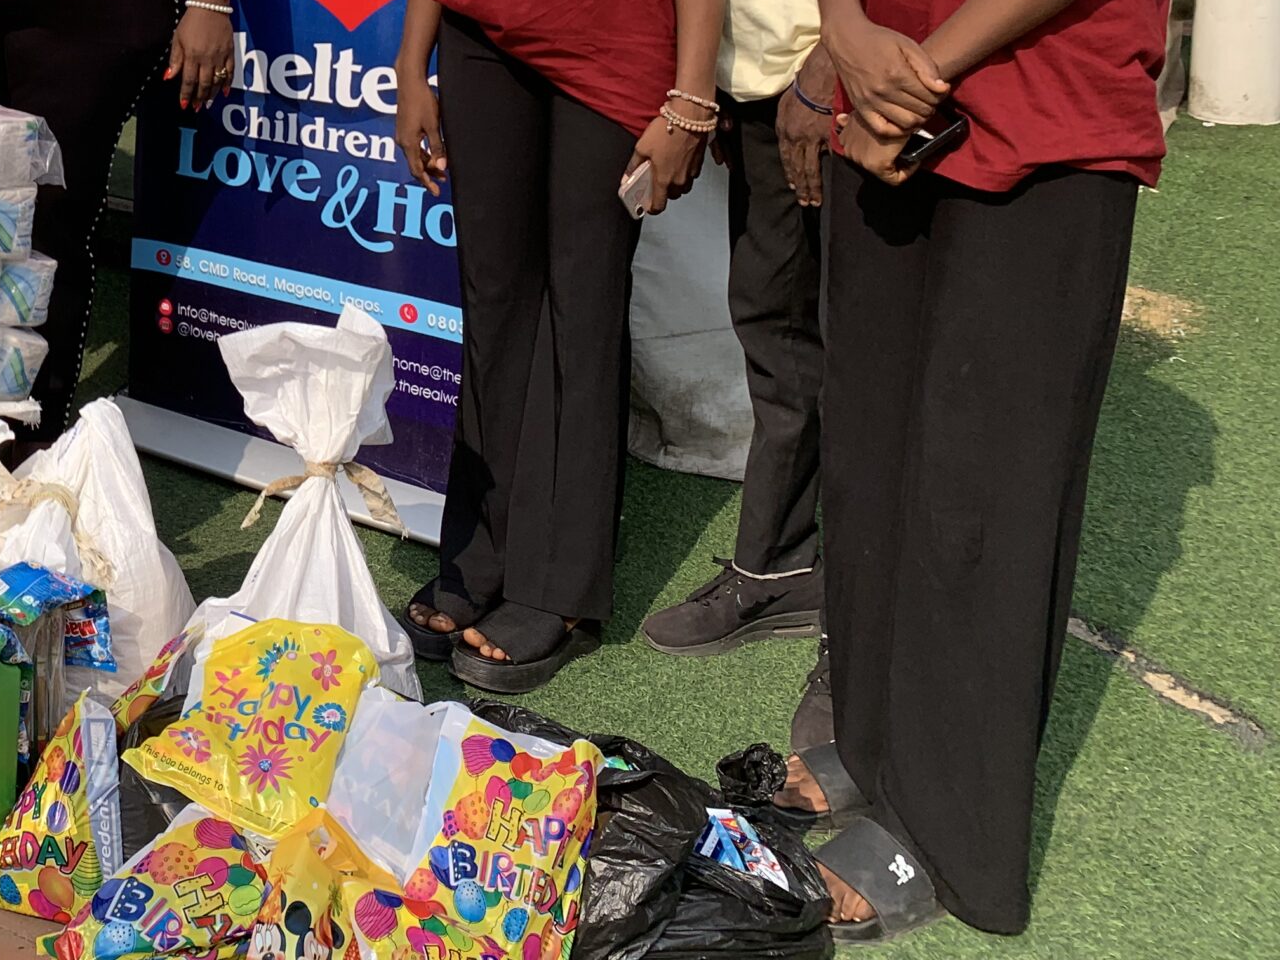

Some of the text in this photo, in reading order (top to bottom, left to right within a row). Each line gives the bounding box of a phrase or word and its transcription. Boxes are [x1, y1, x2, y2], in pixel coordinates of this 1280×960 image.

[231, 31, 399, 114] helte
[222, 104, 397, 162] Children
[176, 127, 457, 253] Love & Ho
[199, 259, 229, 278] CMD
[233, 266, 269, 288] Road,
[274, 275, 334, 306] Magodo,
[392, 355, 462, 385] home@the
[142, 742, 162, 760] This
[177, 761, 213, 786] belongs
[213, 777, 225, 792] to
[97, 797, 116, 883] uredent
